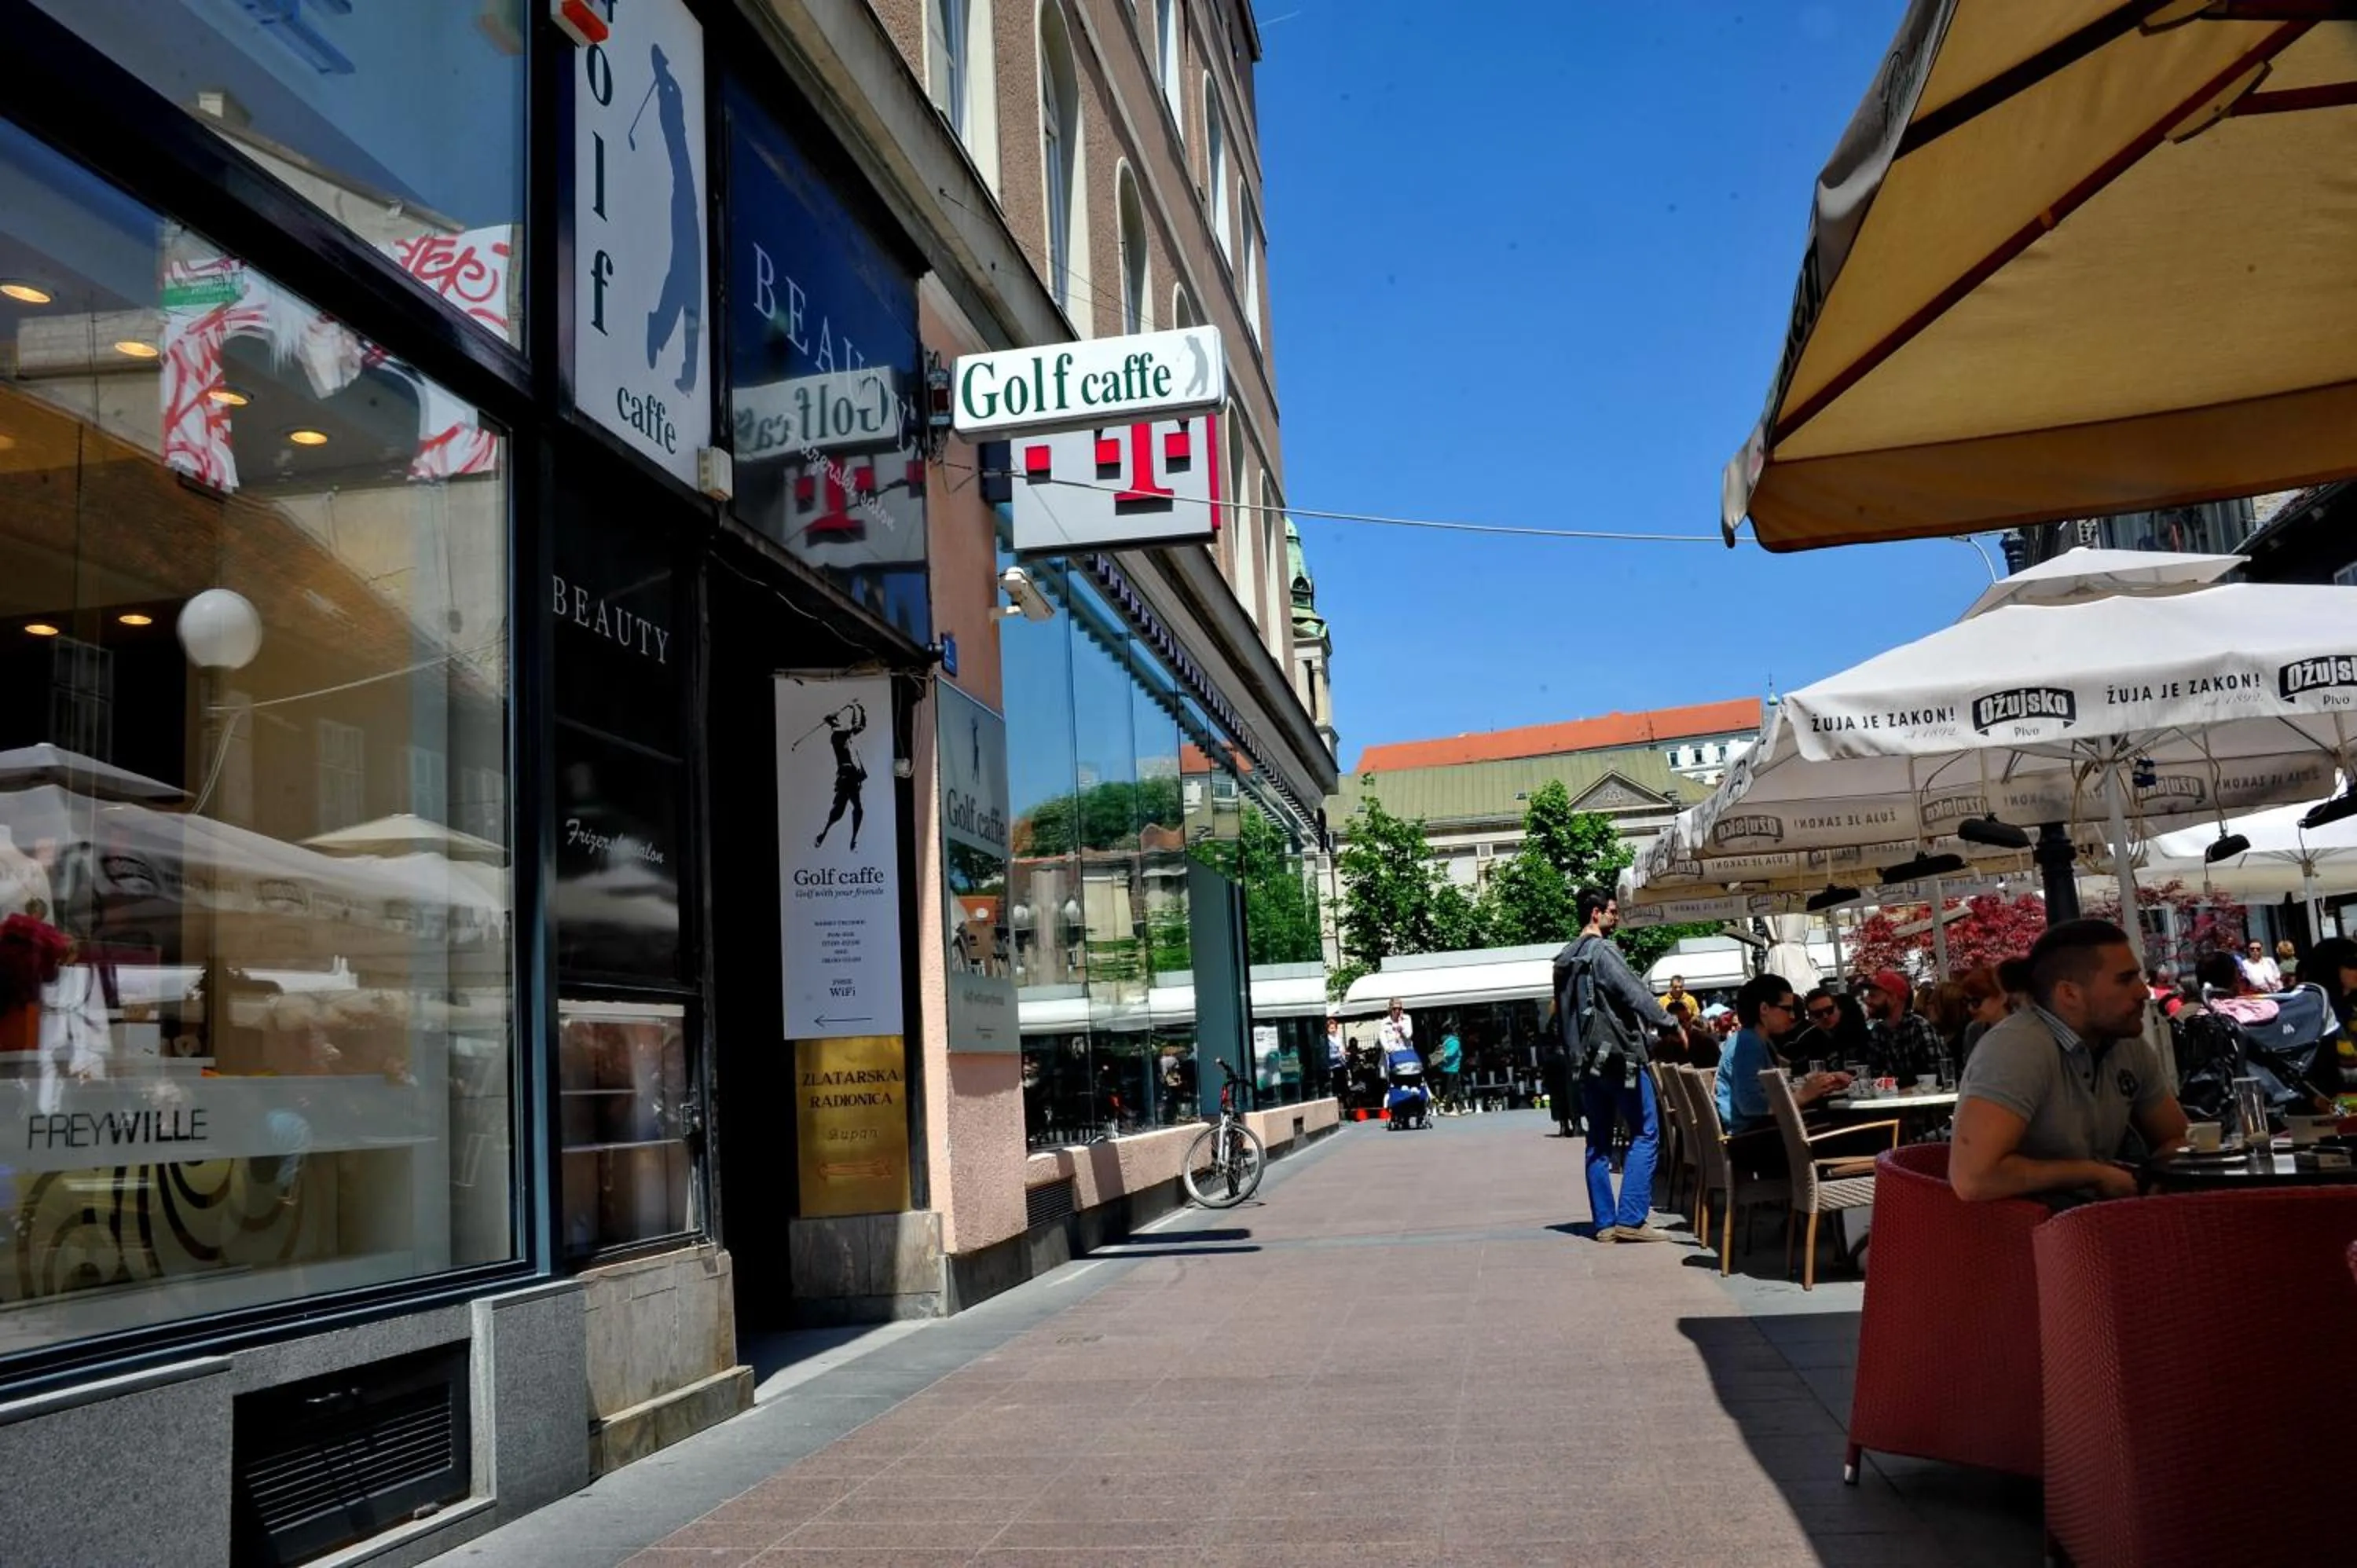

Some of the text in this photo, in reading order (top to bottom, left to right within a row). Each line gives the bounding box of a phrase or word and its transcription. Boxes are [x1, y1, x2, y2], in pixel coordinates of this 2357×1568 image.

[961, 350, 1171, 420] Golf caffe
[618, 385, 677, 455] caffe
[552, 574, 670, 664] BEAUTY
[2106, 672, 2261, 704] ŽUJA JE ZAKON!
[2322, 693, 2351, 706] Pivo
[1811, 706, 1956, 733] ŽUJA JE ZAKON!
[1979, 688, 2069, 725] Ožujsko
[2014, 726, 2040, 738] Pivo
[947, 788, 1006, 847] Golf caffe
[566, 818, 628, 855] Frizers
[794, 866, 885, 886] Golf caffe
[830, 986, 856, 997] WiFi
[801, 1068, 900, 1087] ZLATARSKA
[809, 1093, 893, 1109] RADIONICA
[27, 1108, 208, 1150] FREYWILLE
